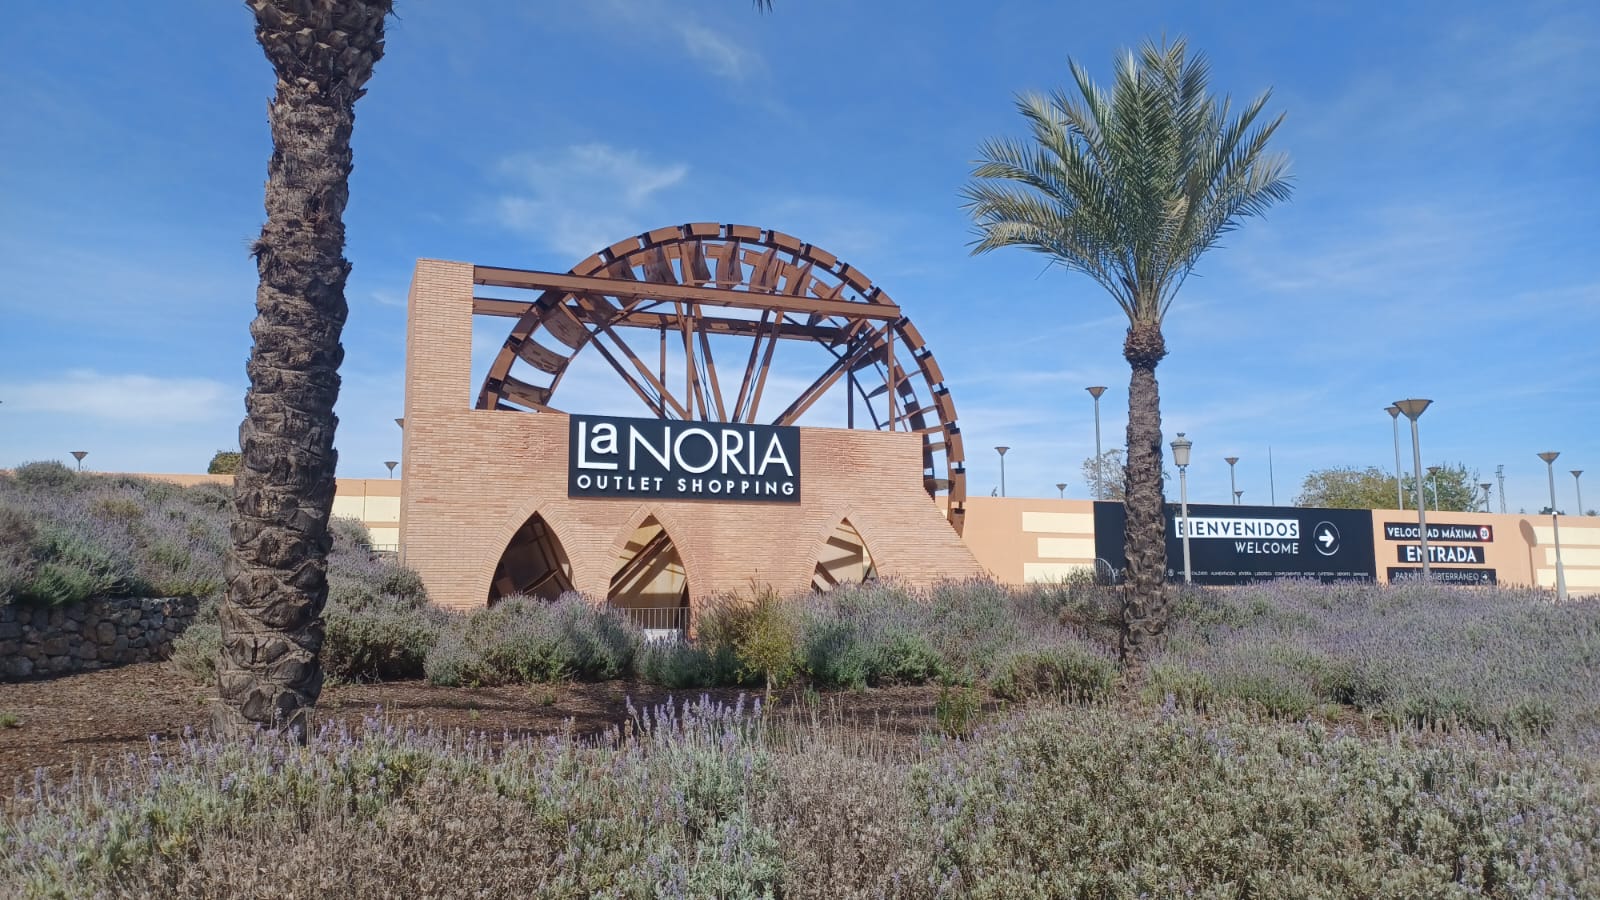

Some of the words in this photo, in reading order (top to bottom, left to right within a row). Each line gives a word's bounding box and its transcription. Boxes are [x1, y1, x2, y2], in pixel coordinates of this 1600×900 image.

[577, 421, 619, 470] La
[629, 424, 794, 477] NORIA
[577, 474, 664, 492] OUTLET
[677, 477, 795, 496] SHOPPING
[1178, 520, 1298, 537] BIENVENIDOS
[1387, 527, 1439, 538] VELOCIAD
[1441, 526, 1477, 539] MÁXIMA
[1235, 542, 1299, 554] WELCOME
